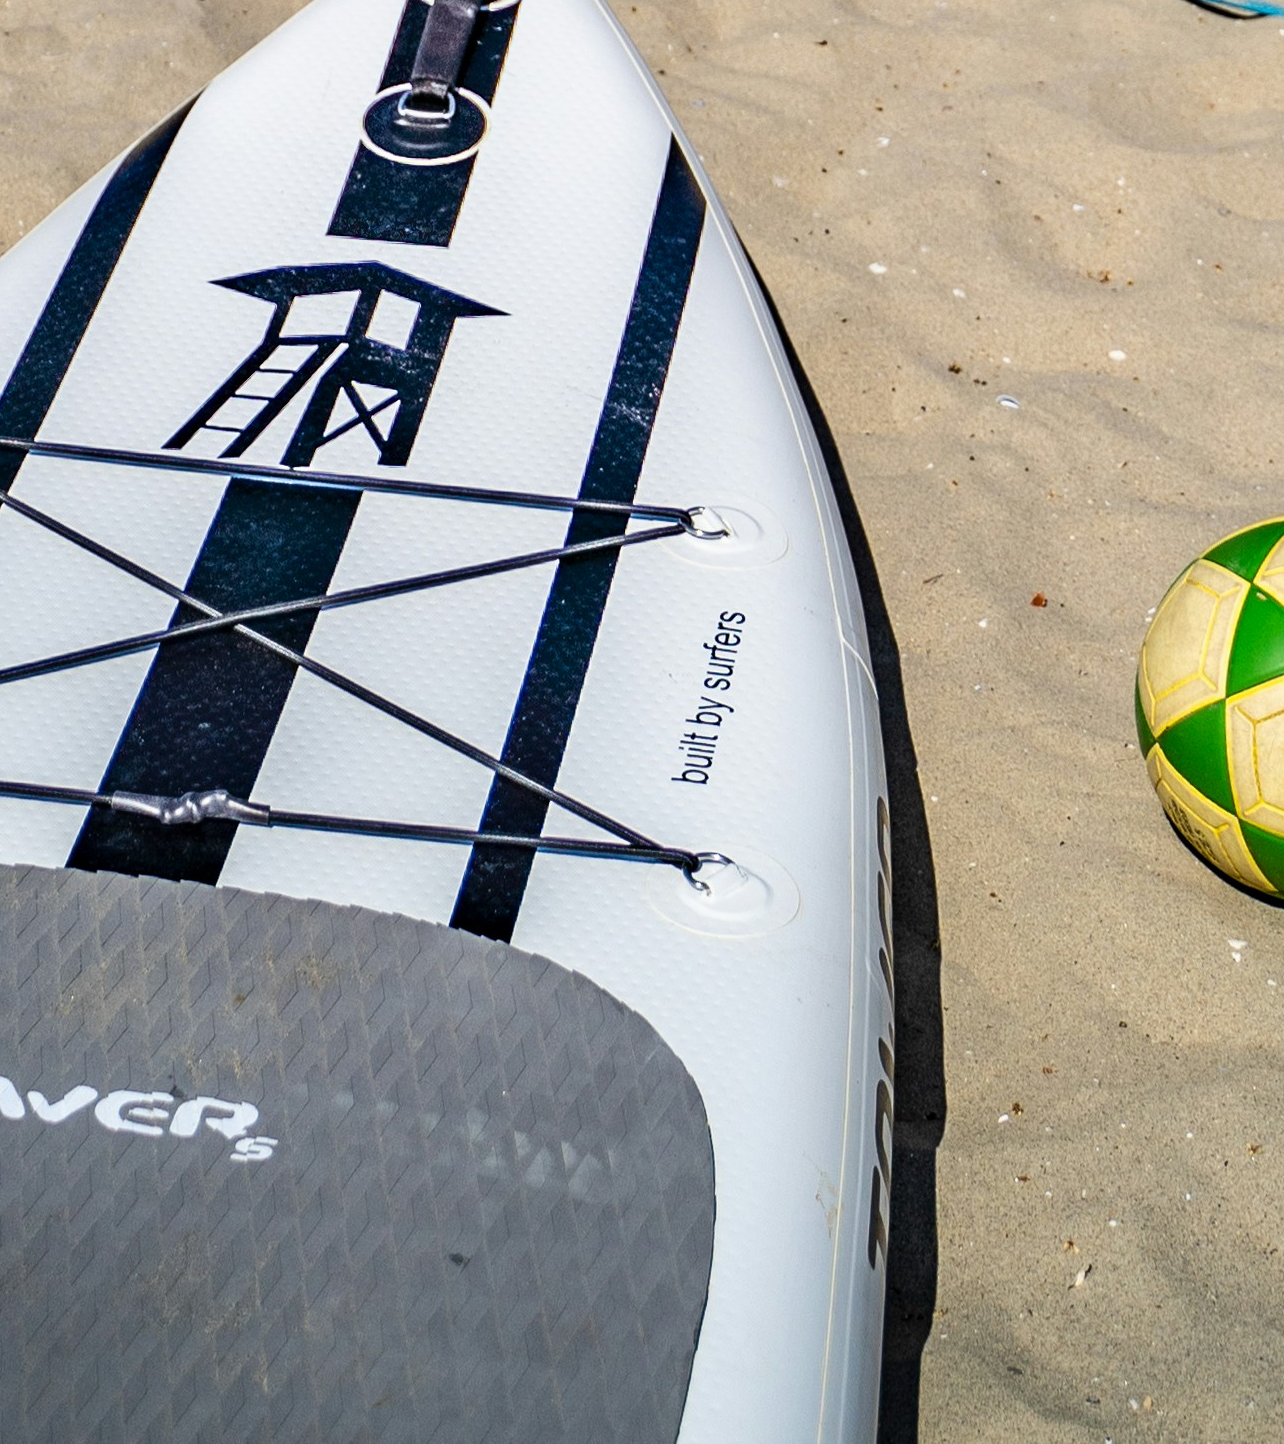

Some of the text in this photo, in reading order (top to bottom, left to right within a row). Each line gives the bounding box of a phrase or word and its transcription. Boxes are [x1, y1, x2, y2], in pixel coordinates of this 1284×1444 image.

[670, 610, 747, 786] built by surfers
